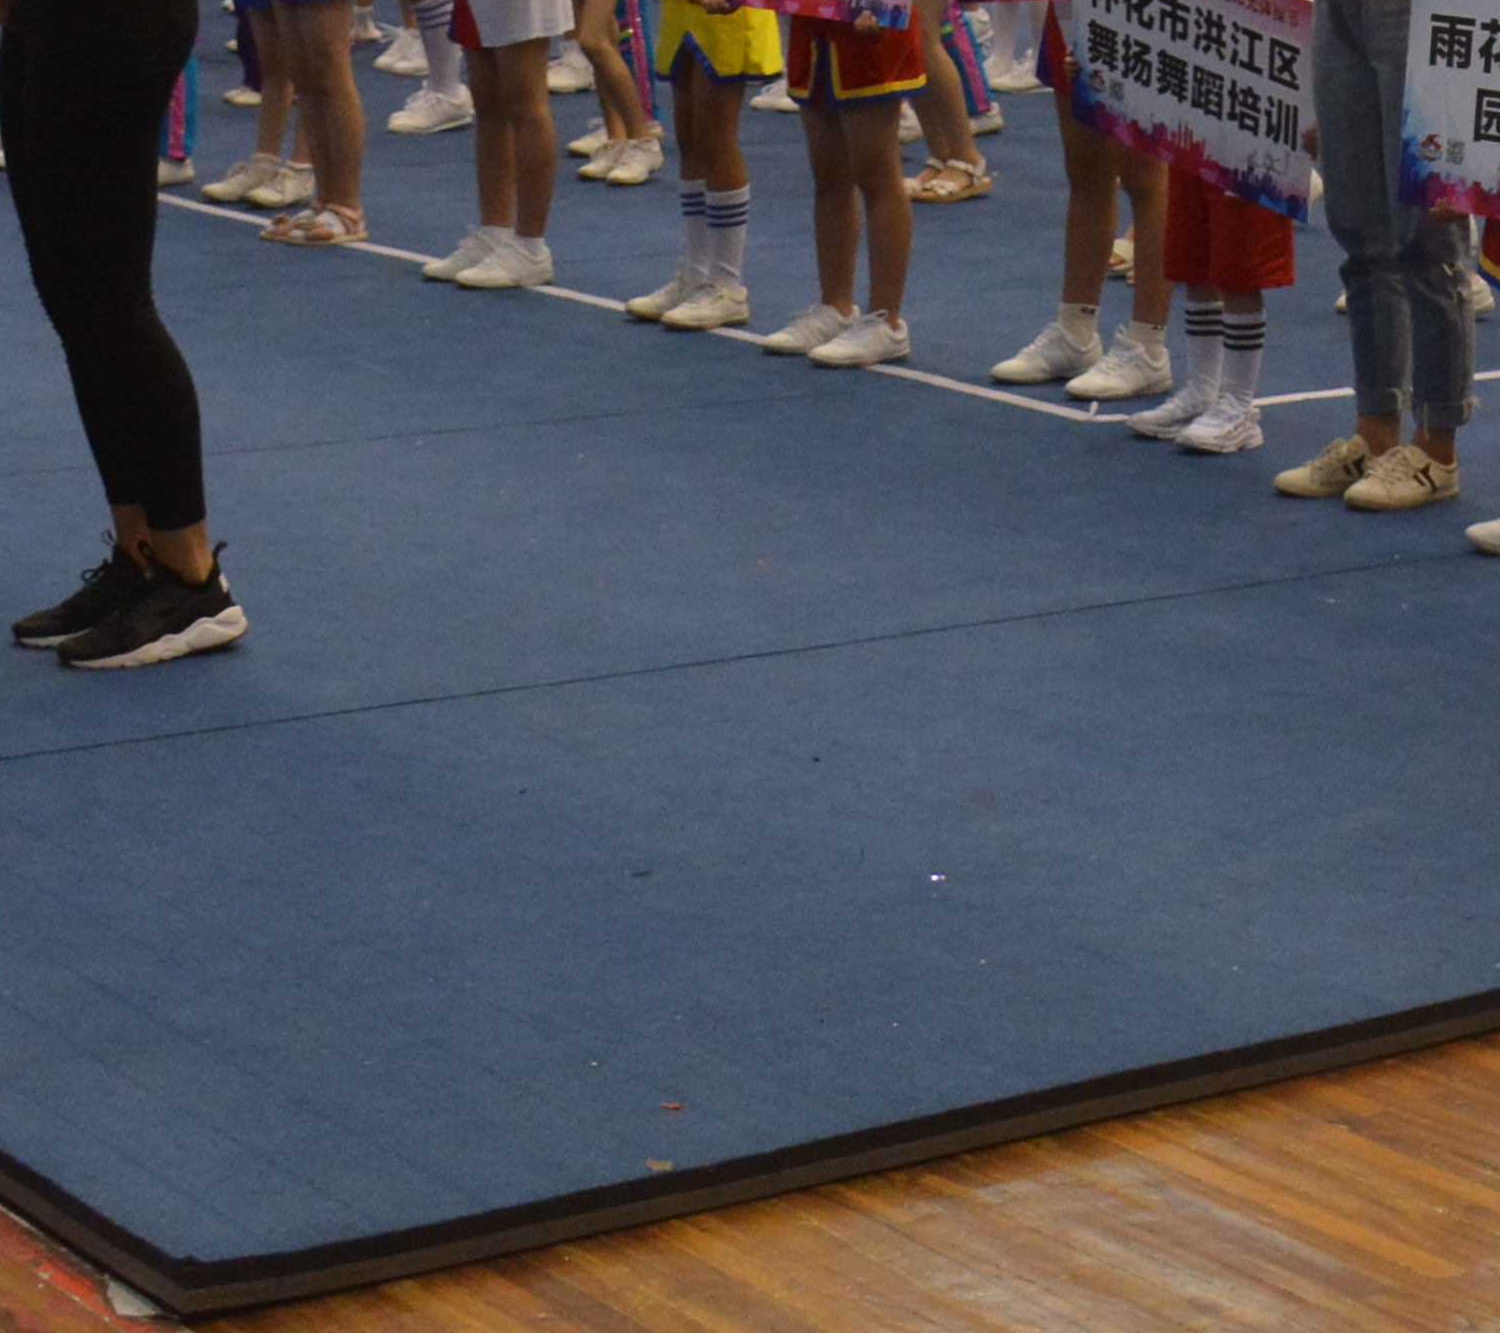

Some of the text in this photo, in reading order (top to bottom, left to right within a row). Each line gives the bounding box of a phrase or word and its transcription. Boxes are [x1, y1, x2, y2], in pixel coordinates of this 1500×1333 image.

[1086, 19, 1300, 153] 舞扬舞蹈培训
